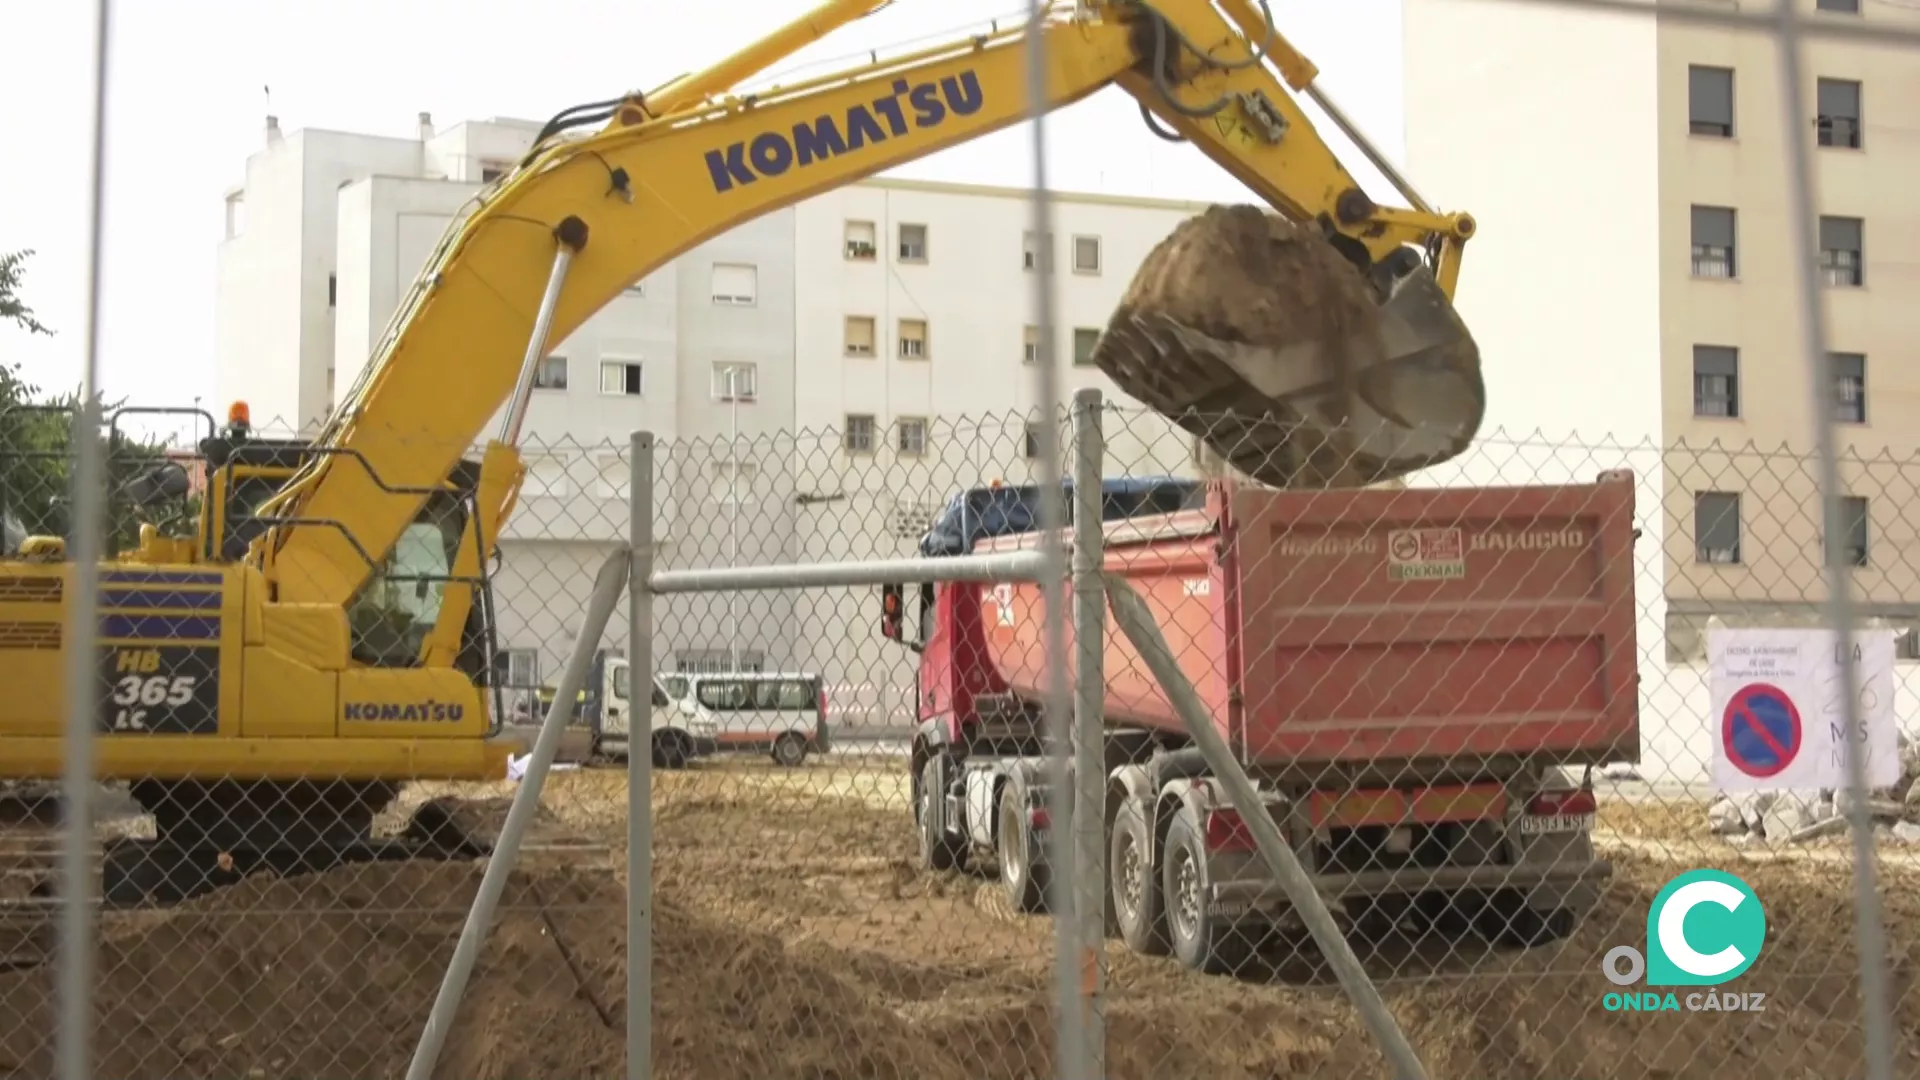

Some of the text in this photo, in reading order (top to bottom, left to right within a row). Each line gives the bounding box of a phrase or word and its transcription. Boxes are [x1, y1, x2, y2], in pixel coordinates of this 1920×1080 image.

[704, 69, 983, 194] KOMATSU
[116, 650, 161, 673] HB
[113, 676, 195, 706] 365
[115, 711, 147, 730] LC
[344, 699, 464, 722] KOMATSU
